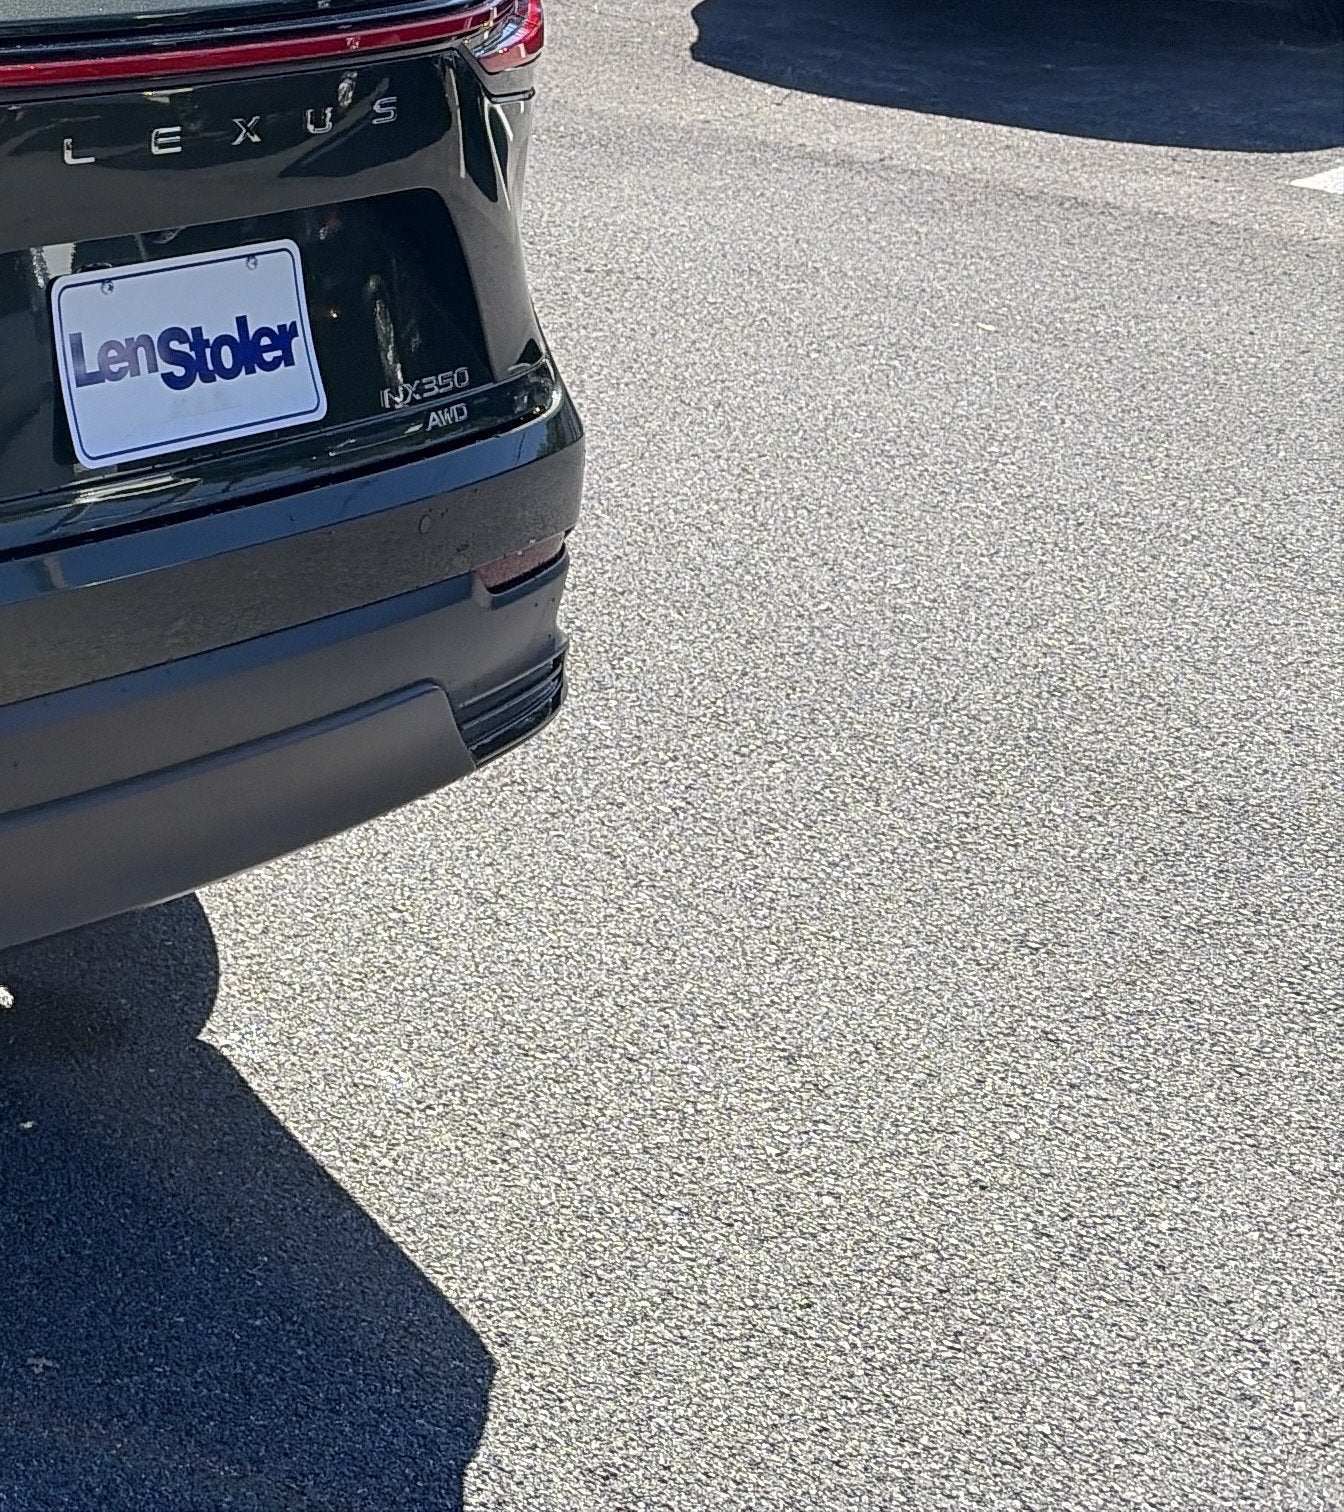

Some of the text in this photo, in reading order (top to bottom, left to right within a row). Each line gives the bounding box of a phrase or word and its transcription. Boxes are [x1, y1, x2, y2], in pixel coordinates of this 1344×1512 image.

[63, 96, 398, 165] LEXUS
[379, 366, 470, 409] NX350
[425, 402, 468, 432] AWD
